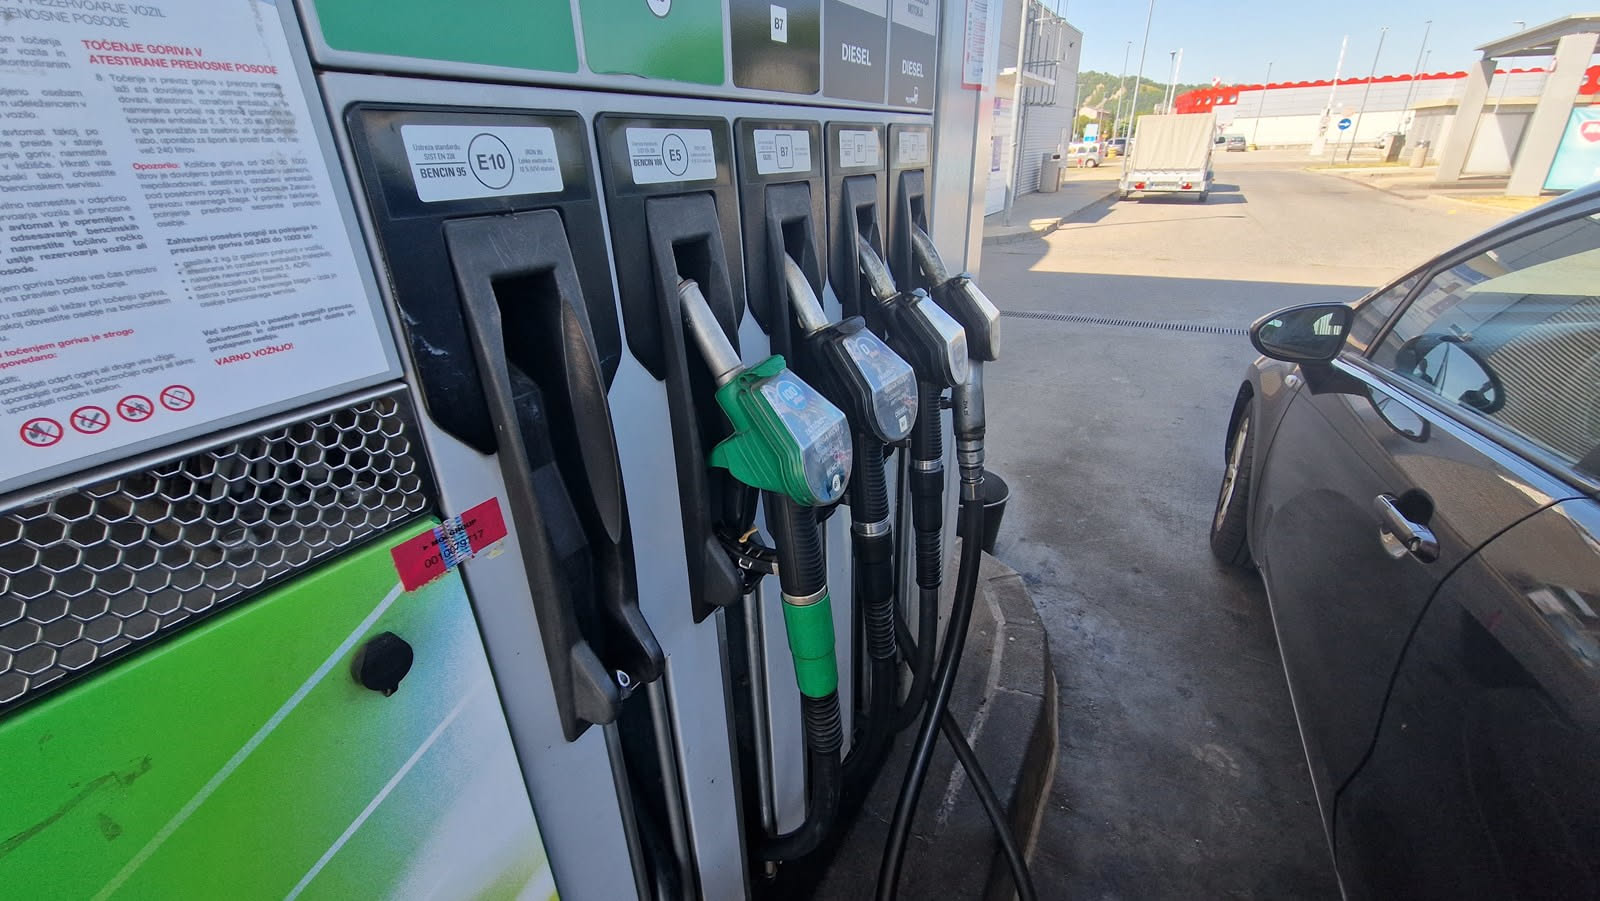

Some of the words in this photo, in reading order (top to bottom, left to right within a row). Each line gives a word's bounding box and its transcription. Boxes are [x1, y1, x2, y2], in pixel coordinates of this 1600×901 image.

[128, 4, 166, 18] VOZIL
[72, 13, 130, 28] POSODE
[774, 18, 784, 30] B7
[82, 40, 145, 53] TOČENJE
[147, 45, 193, 56] GORIVA
[194, 48, 202, 57] V
[842, 43, 871, 65] DIESEL
[90, 54, 169, 68] ATESTIRANE
[169, 59, 234, 72] PRENOSNE
[234, 63, 278, 75] POSODE
[902, 59, 924, 78] DIESEL
[669, 149, 681, 161] E5
[781, 147, 788, 157] B7
[477, 154, 506, 170] E10
[420, 168, 455, 178] BENCIN
[456, 167, 466, 176] 95
[8, 221, 55, 231] avtomat
[58, 220, 69, 229] je
[74, 216, 125, 226] opremljen
[10, 229, 78, 242] odsesavanje
[10, 241, 65, 253] namestite
[72, 237, 108, 246] točilno
[115, 233, 144, 242] ročko
[5, 255, 34, 264] ustje
[39, 248, 99, 261] rezervoarja
[102, 244, 132, 253] vozila
[22, 280, 55, 291] goriva
[55, 275, 87, 285] bodite
[62, 285, 90, 296] potek
[25, 314, 71, 327] obvestite
[72, 309, 104, 319] osebje
[4, 343, 56, 357] točenjem
[57, 337, 90, 349] goriva
[90, 334, 101, 342] je
[102, 328, 135, 339] strogo
[214, 352, 252, 366] VARNO
[252, 342, 294, 357] VOŽNJO!
